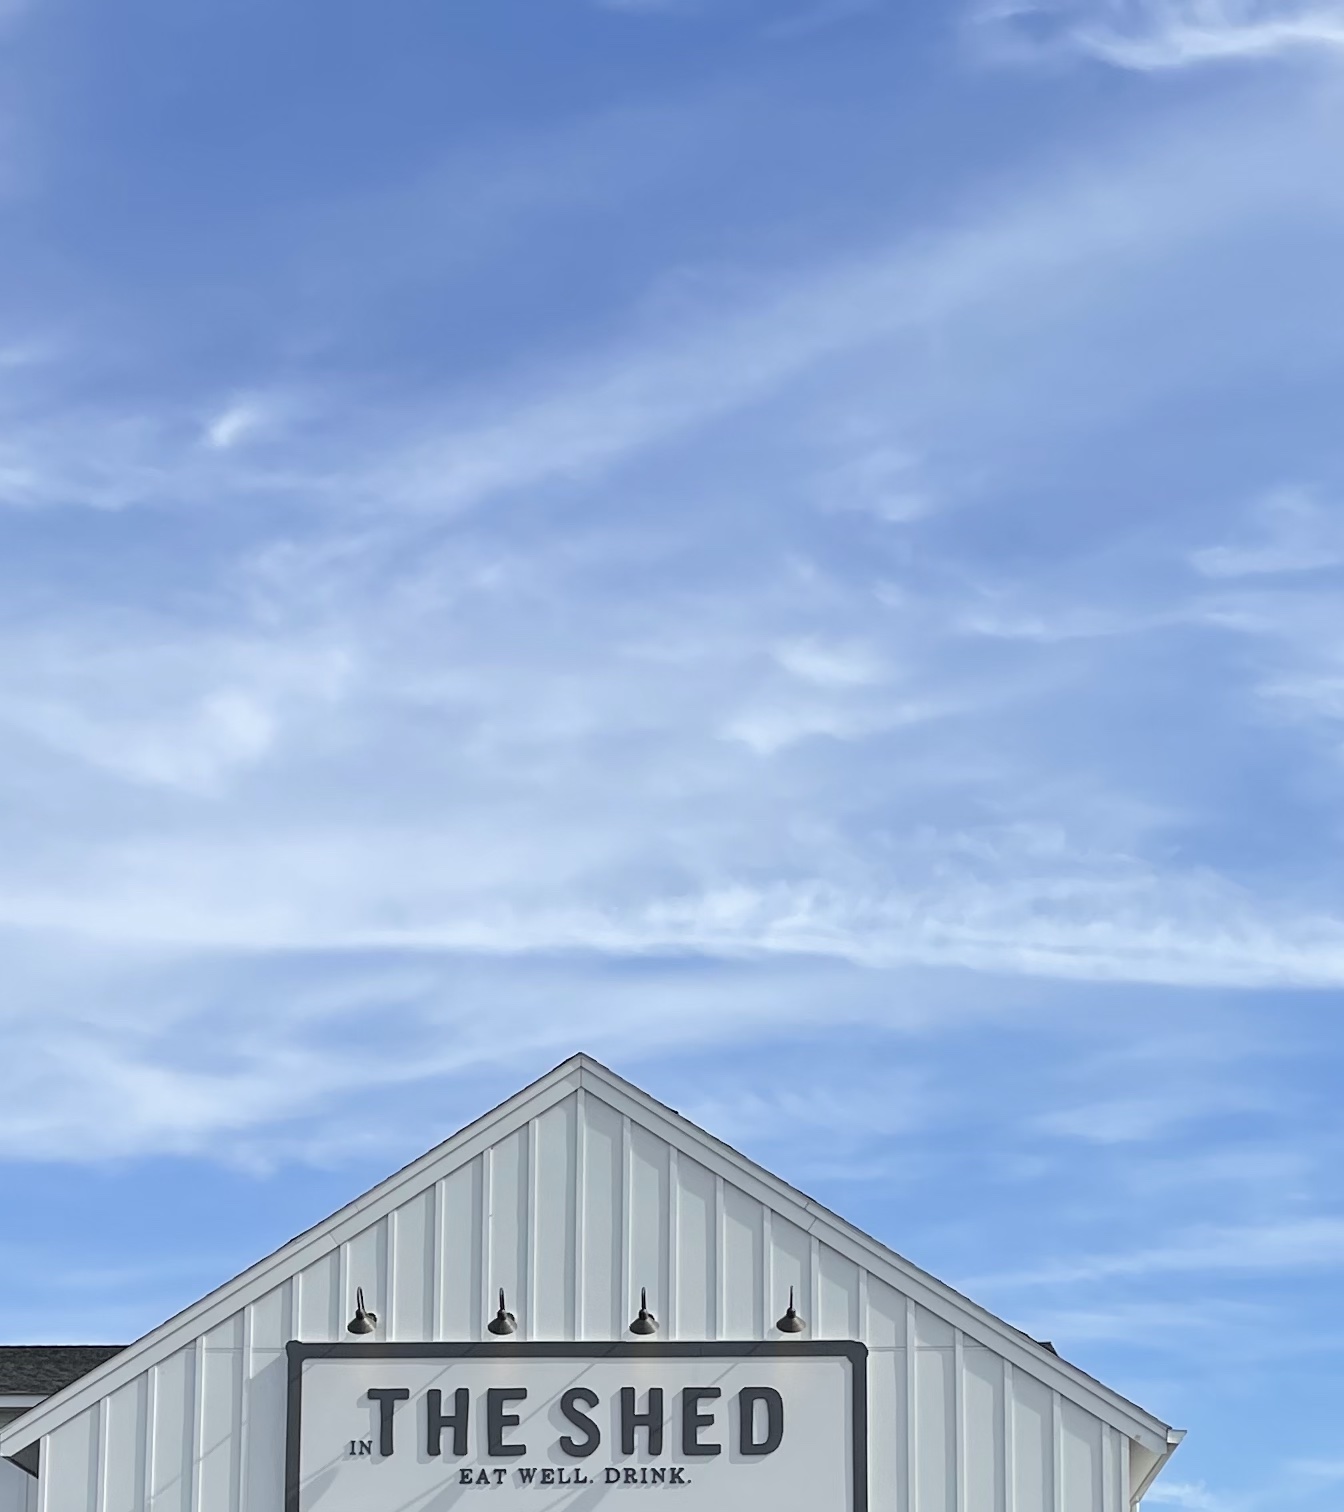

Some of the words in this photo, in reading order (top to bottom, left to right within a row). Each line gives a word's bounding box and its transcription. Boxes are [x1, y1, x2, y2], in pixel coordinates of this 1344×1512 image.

[349, 1440, 373, 1456] IN
[367, 1387, 528, 1457] THE
[559, 1386, 785, 1458] SHED
[459, 1467, 508, 1485] EAT
[517, 1467, 595, 1485] WELL.
[604, 1467, 693, 1485] DRINK.
